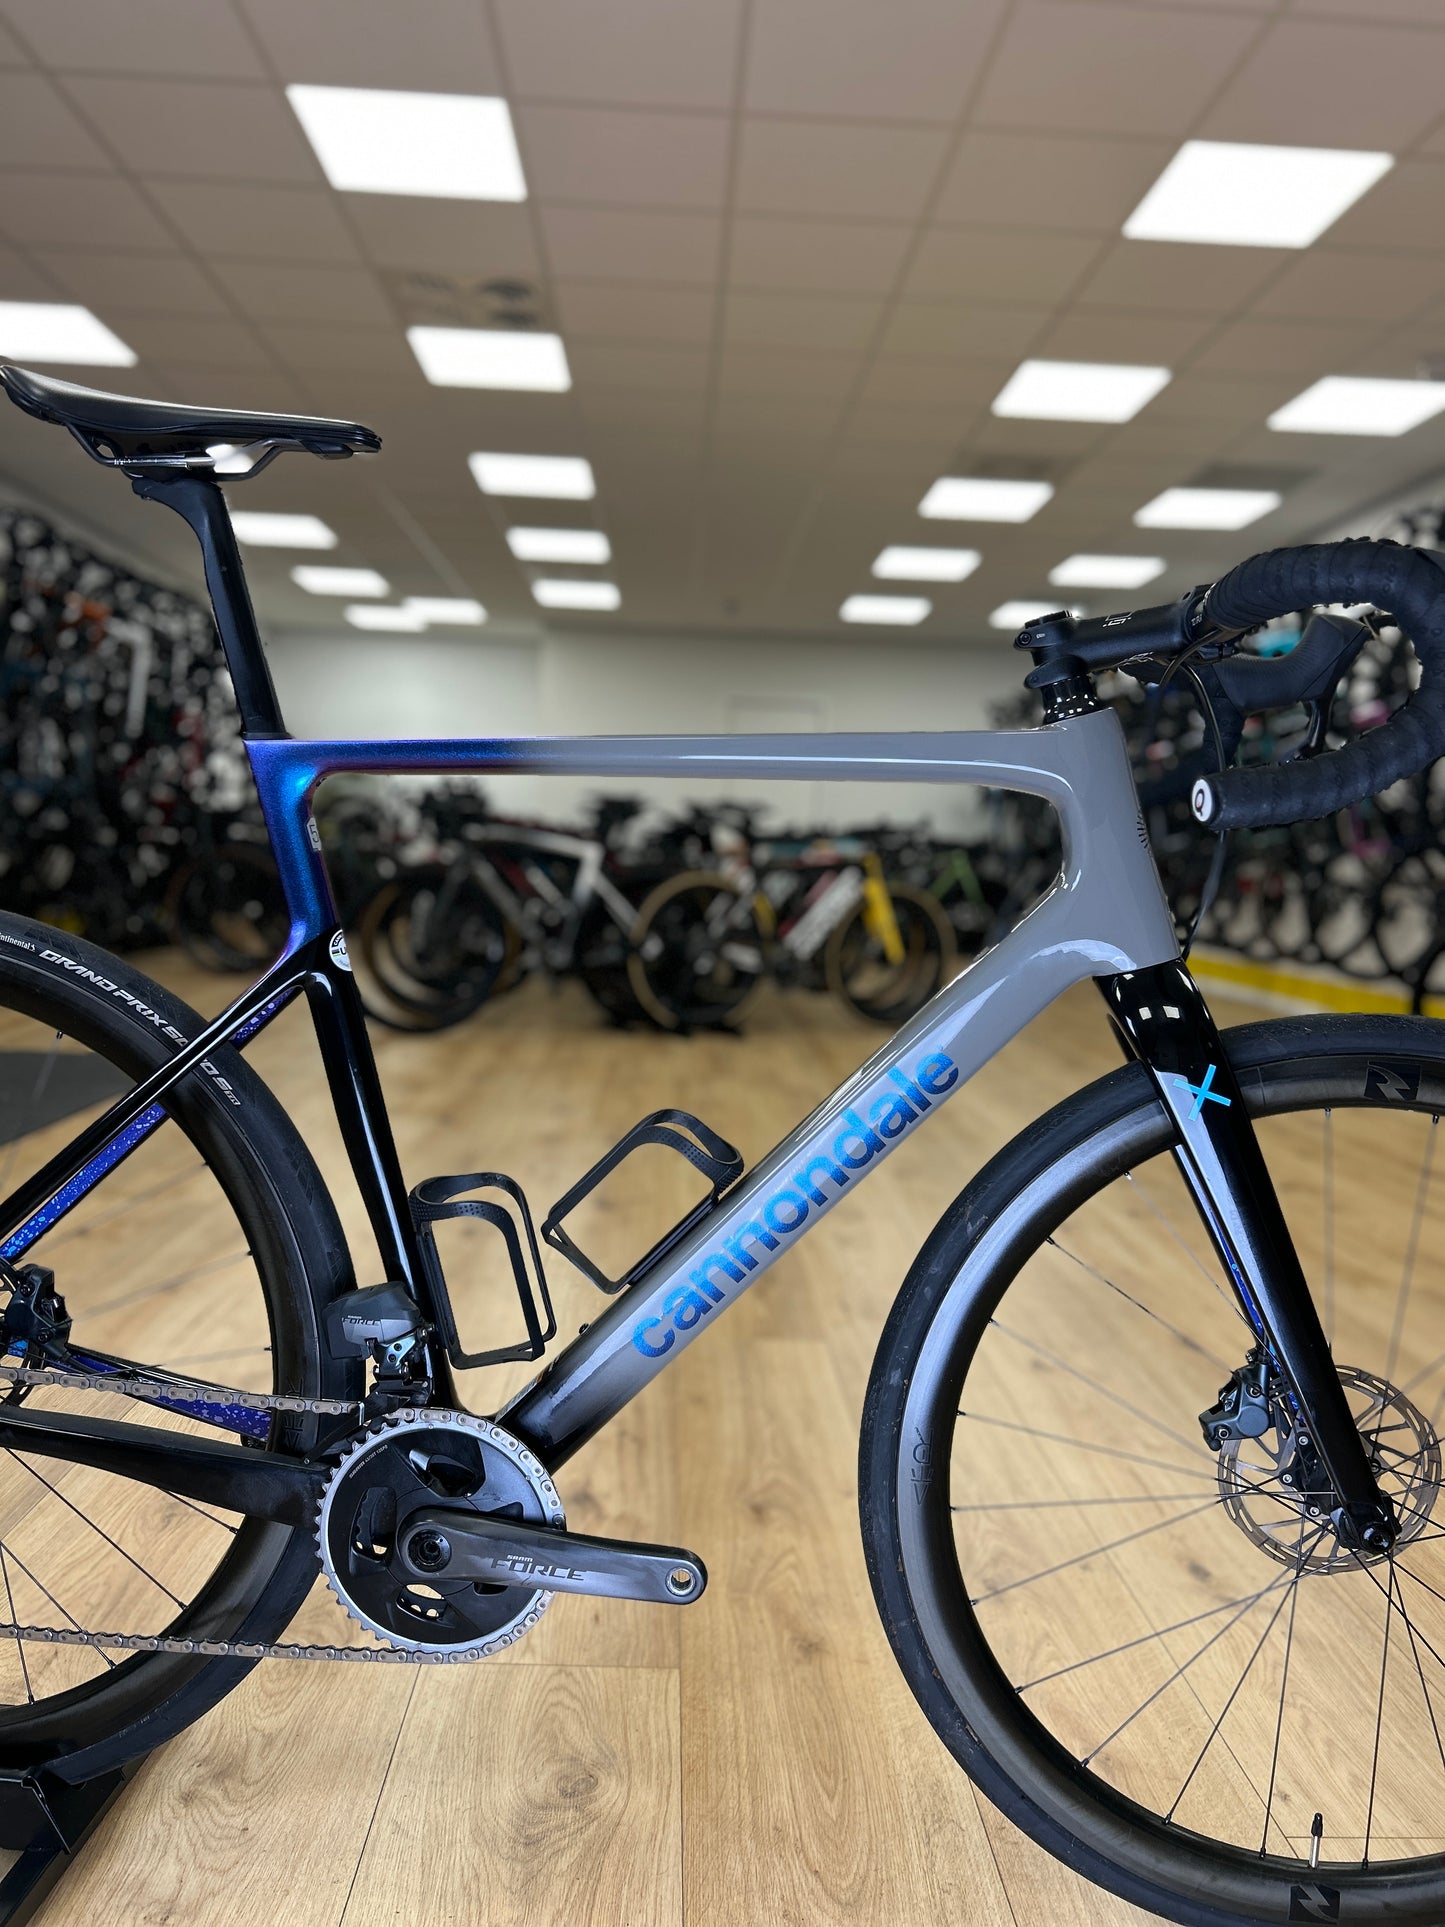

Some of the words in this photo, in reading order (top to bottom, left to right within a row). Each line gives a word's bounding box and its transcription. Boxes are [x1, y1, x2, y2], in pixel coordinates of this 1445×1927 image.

[0, 932, 31, 951] ntinental
[39, 949, 119, 992] GRAND
[112, 989, 169, 1027] PRIX
[161, 1025, 220, 1076] 500
[631, 1050, 960, 1359] cannondale
[490, 1557, 587, 1582] FORCE
